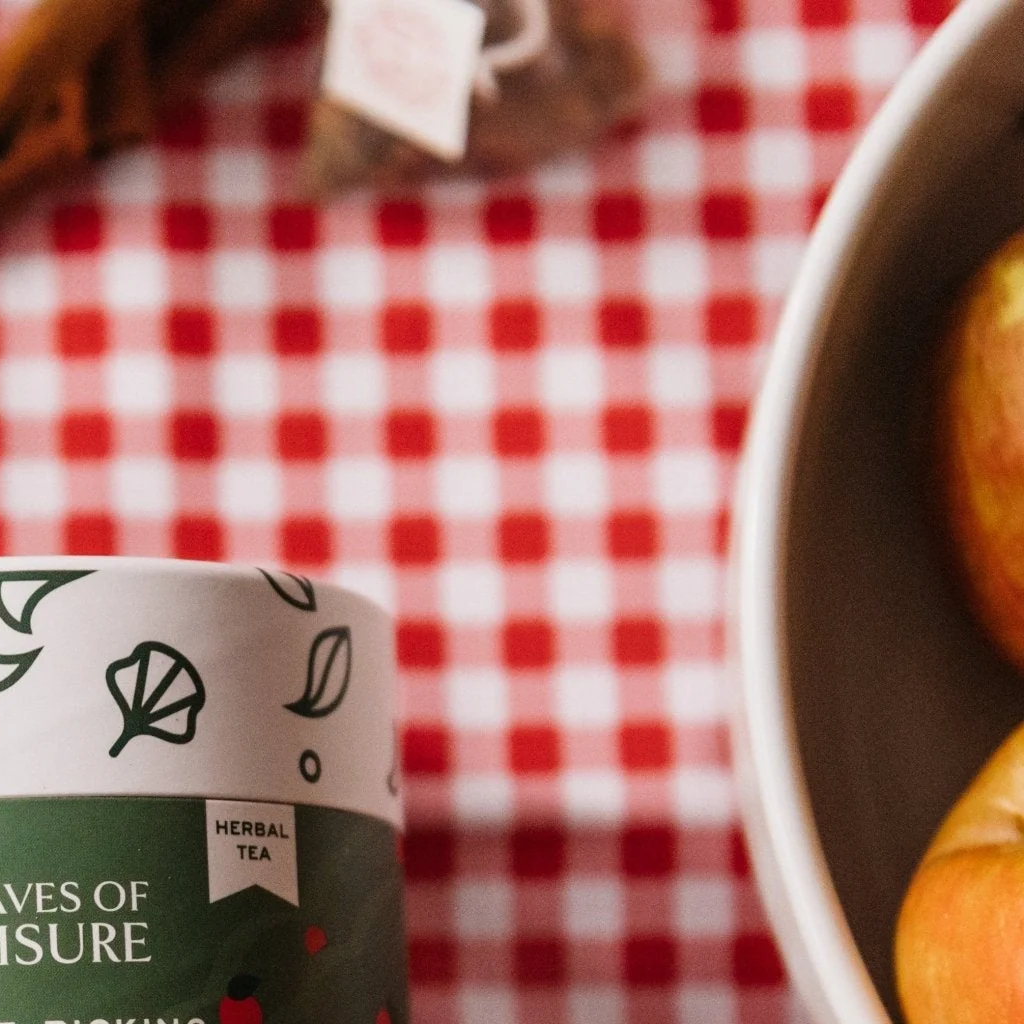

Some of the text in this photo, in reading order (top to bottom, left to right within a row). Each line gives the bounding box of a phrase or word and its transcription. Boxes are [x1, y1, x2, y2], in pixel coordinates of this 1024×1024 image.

[215, 819, 289, 839] HERBAL
[236, 844, 271, 861] TEA
[93, 880, 150, 912] OF
